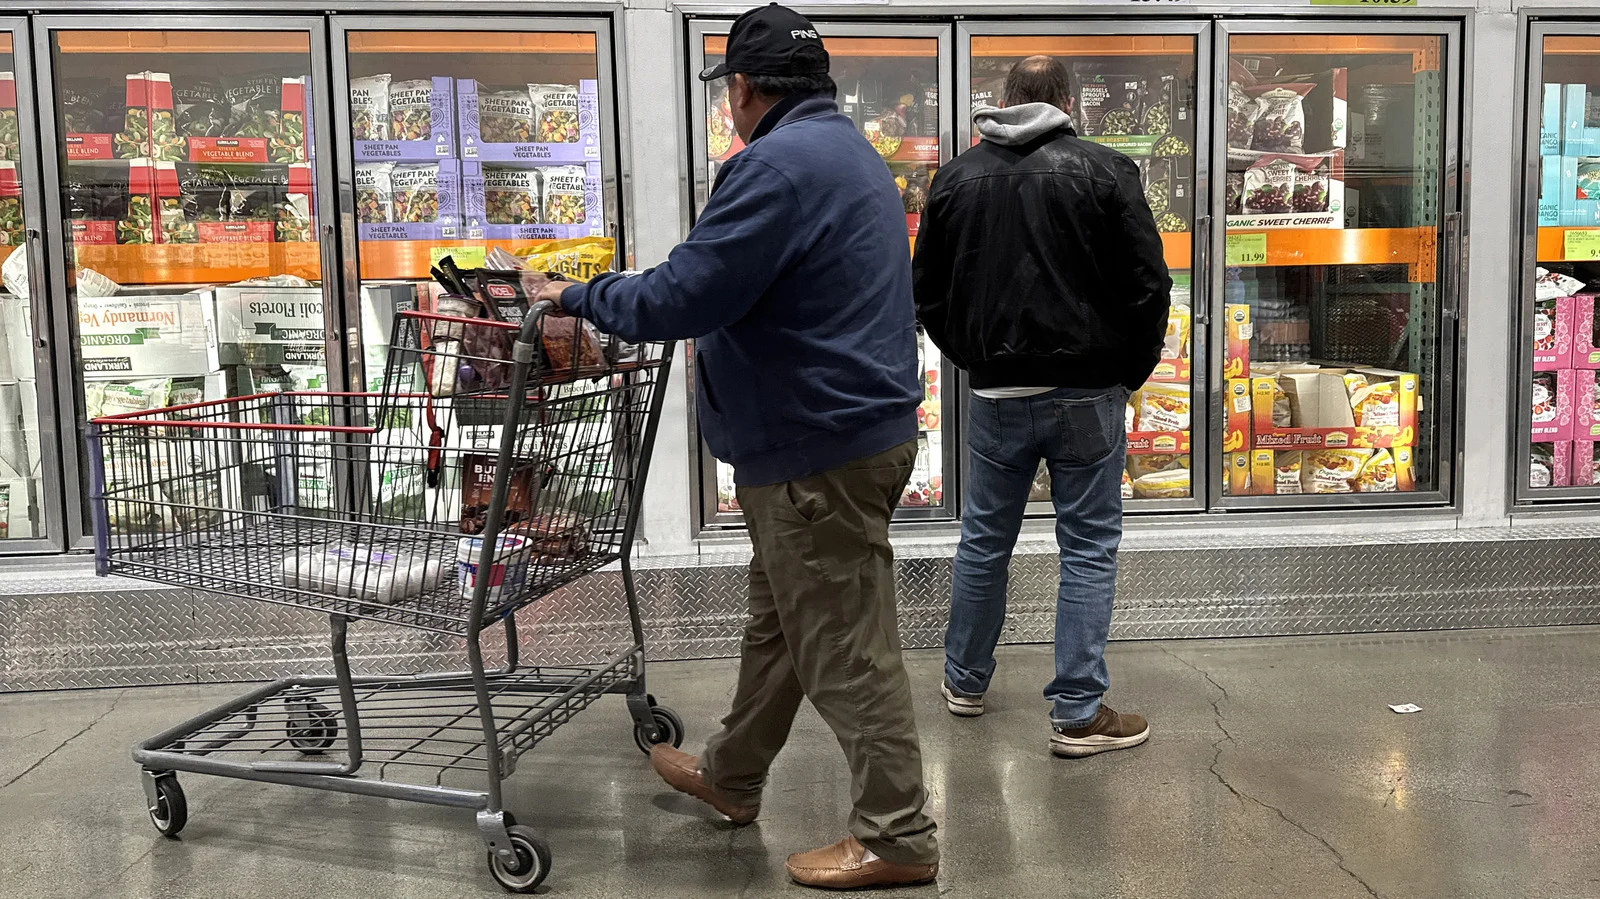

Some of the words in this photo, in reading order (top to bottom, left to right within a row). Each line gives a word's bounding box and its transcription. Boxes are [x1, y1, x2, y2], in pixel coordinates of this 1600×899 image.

[791, 30, 817, 39] PING
[176, 89, 219, 99] GETABLE
[390, 90, 413, 99] SHEET
[971, 91, 993, 100] TABLE
[391, 96, 431, 106] EGETABLE
[485, 98, 509, 106] SHEET
[971, 100, 987, 108] NGE
[481, 105, 530, 115] VEGETABLES
[355, 177, 376, 185] BLES
[484, 179, 530, 187] VEGETABLES
[549, 183, 585, 191] EGETABL
[1257, 218, 1292, 227] SWEET
[1241, 252, 1265, 262] 11.99
[548, 259, 602, 279] IGHTS
[490, 286, 513, 296] NOEL
[249, 302, 296, 317] Florets
[300, 302, 323, 318] coli
[102, 310, 176, 327] Normandy
[81, 334, 131, 345] ORGANIC
[285, 352, 325, 360] KIRKLAND
[84, 362, 130, 371] KIRKLAND
[1256, 434, 1292, 445] Mixed
[1293, 433, 1322, 444] Fruit
[478, 473, 497, 483] EN
